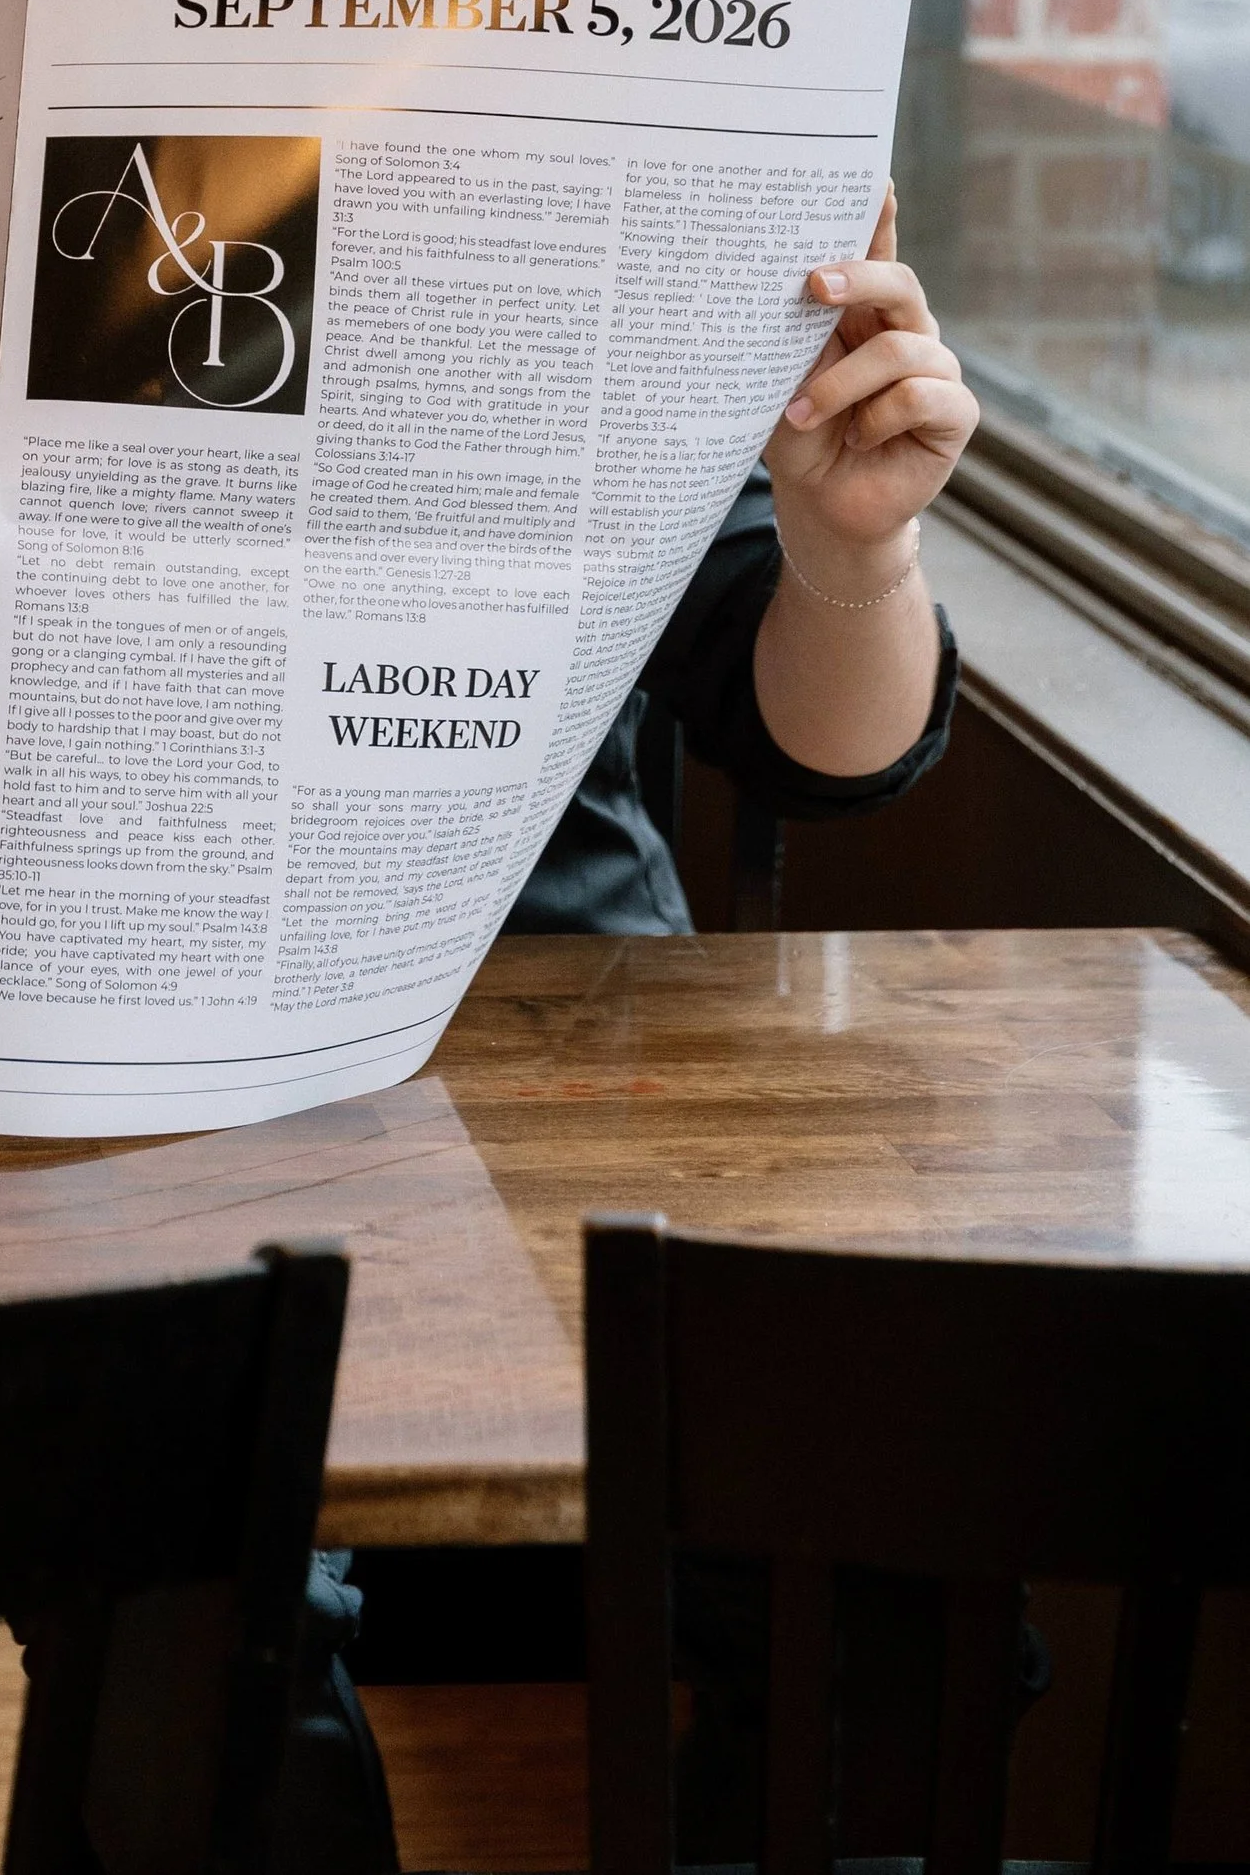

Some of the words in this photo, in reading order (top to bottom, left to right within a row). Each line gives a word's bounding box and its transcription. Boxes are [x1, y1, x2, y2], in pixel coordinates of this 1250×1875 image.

[335, 154, 367, 167] Song
[370, 155, 384, 165] of
[385, 156, 440, 168] Solomon
[442, 160, 461, 170] 3:4
[627, 158, 638, 168] in
[643, 159, 667, 171] love
[671, 161, 687, 171] for
[692, 164, 714, 173] one
[718, 164, 762, 176] another
[766, 166, 788, 177] and
[792, 167, 807, 178] for
[828, 170, 840, 179] as
[842, 170, 858, 179] we
[860, 169, 874, 179] do
[599, 420, 649, 432] Proverbs
[651, 422, 677, 432] 3:3-4
[315, 448, 376, 460] Colossians
[378, 451, 415, 463] 3:14-17
[21, 480, 65, 496] blazing
[96, 485, 117, 496] like
[120, 488, 128, 497] a
[132, 487, 176, 501] mighty
[220, 492, 252, 505] Many
[256, 495, 296, 506] waters
[310, 491, 325, 502] he
[329, 492, 373, 504] created
[414, 496, 439, 507] And
[442, 497, 466, 508] God
[470, 498, 513, 510] blessed
[553, 503, 577, 514] And
[15, 600, 65, 613] Romans
[67, 602, 89, 613] 13:8
[321, 661, 458, 699] LABOR
[465, 668, 541, 701] DAY
[329, 713, 522, 751] WEEKEND
[291, 801, 305, 810] so
[312, 801, 339, 811] shall
[345, 803, 371, 813] your
[378, 803, 404, 812] sons
[410, 803, 442, 814] marry
[473, 798, 492, 810] and
[496, 797, 506, 805] as
[511, 792, 525, 803] the
[0, 825, 87, 839] righteousness
[95, 829, 119, 840] and
[128, 832, 164, 843] peace
[173, 832, 195, 843] kiss
[203, 833, 232, 845] each
[278, 945, 311, 956] Psalm
[313, 944, 338, 955] 143:8
